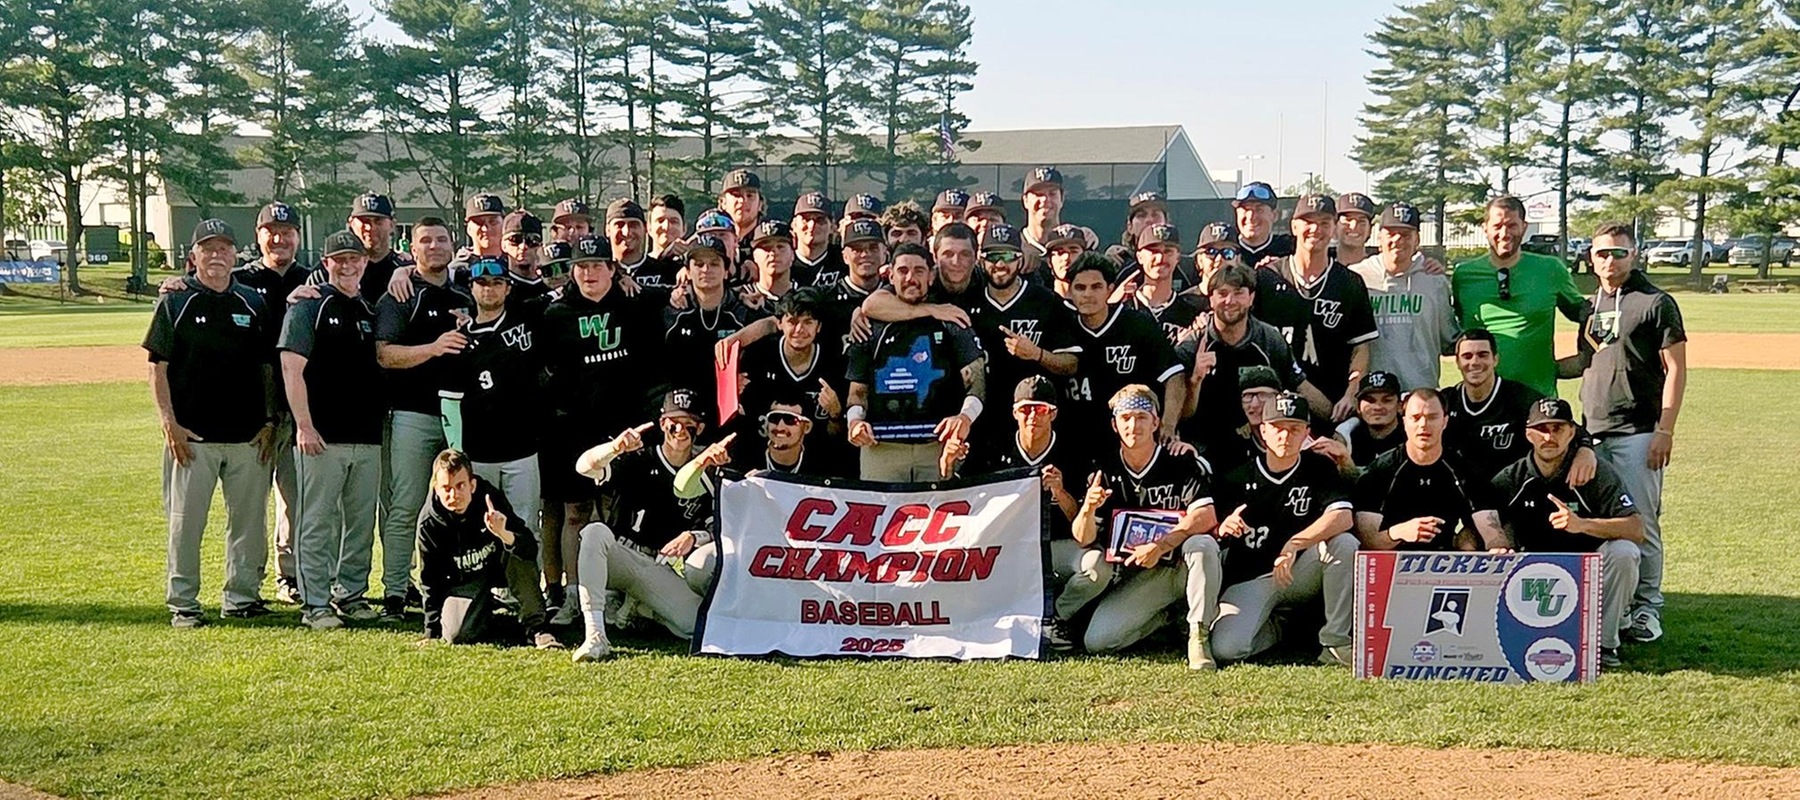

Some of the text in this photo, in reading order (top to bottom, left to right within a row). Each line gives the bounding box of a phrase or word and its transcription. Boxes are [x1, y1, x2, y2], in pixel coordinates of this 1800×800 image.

[88, 254, 108, 262] 360
[1314, 299, 1343, 329] WU
[1370, 293, 1423, 315] WILMU
[501, 323, 532, 351] WU
[578, 312, 622, 350] WU
[1105, 345, 1137, 374] WU
[478, 370, 494, 390] 9
[1480, 423, 1515, 449] WU
[1148, 484, 1180, 510] WU
[786, 497, 971, 547] CACC
[748, 545, 1002, 584] CHAMPION
[1398, 555, 1516, 575] TICKET
[1520, 578, 1567, 617] WU
[801, 600, 950, 626] BASEBALL
[840, 637, 906, 653] 2025
[1390, 665, 1510, 682] PUNCHED
